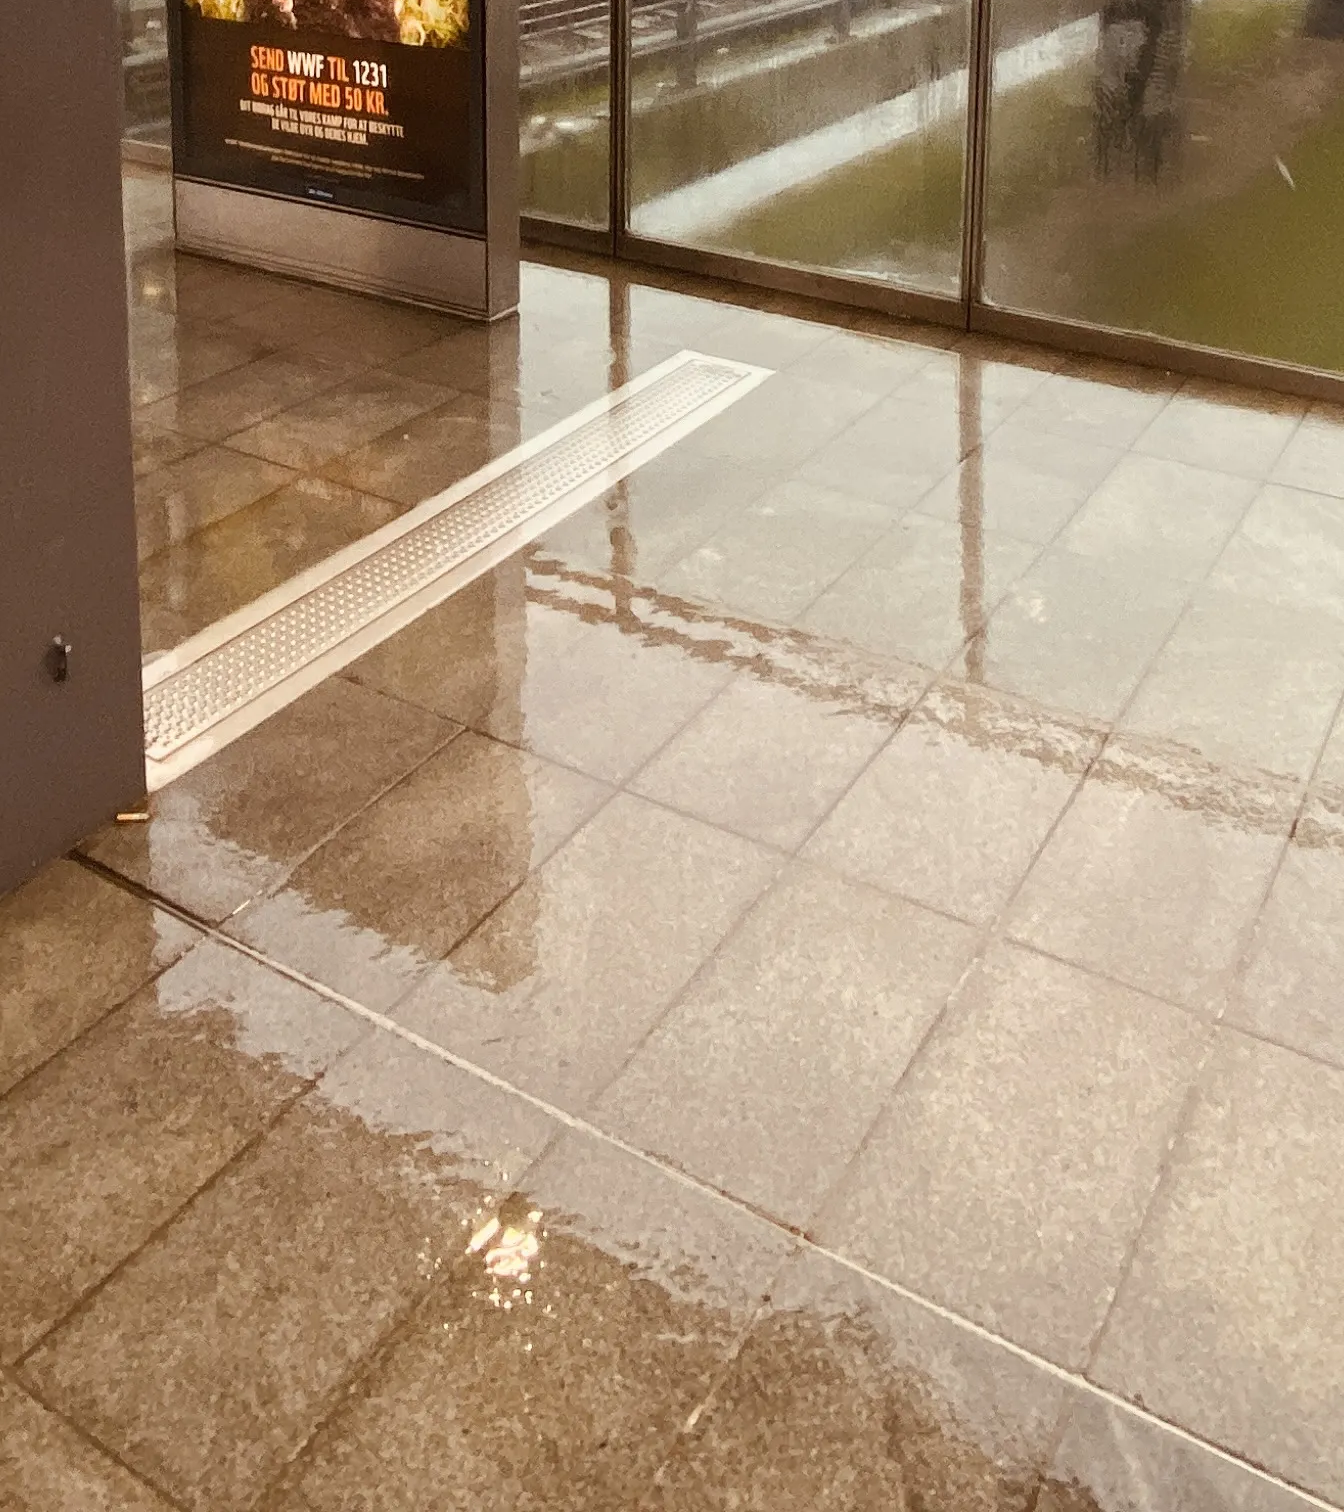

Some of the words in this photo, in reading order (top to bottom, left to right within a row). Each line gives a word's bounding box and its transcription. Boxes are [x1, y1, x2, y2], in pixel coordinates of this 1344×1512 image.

[250, 45, 284, 72] SEND
[287, 50, 324, 78] WWF
[327, 56, 349, 82] TIL
[353, 60, 388, 88] 1231
[251, 72, 269, 97] OG
[271, 75, 306, 102] STØT
[309, 81, 341, 108] MED
[345, 86, 362, 112] 50
[366, 90, 389, 116] KR.
